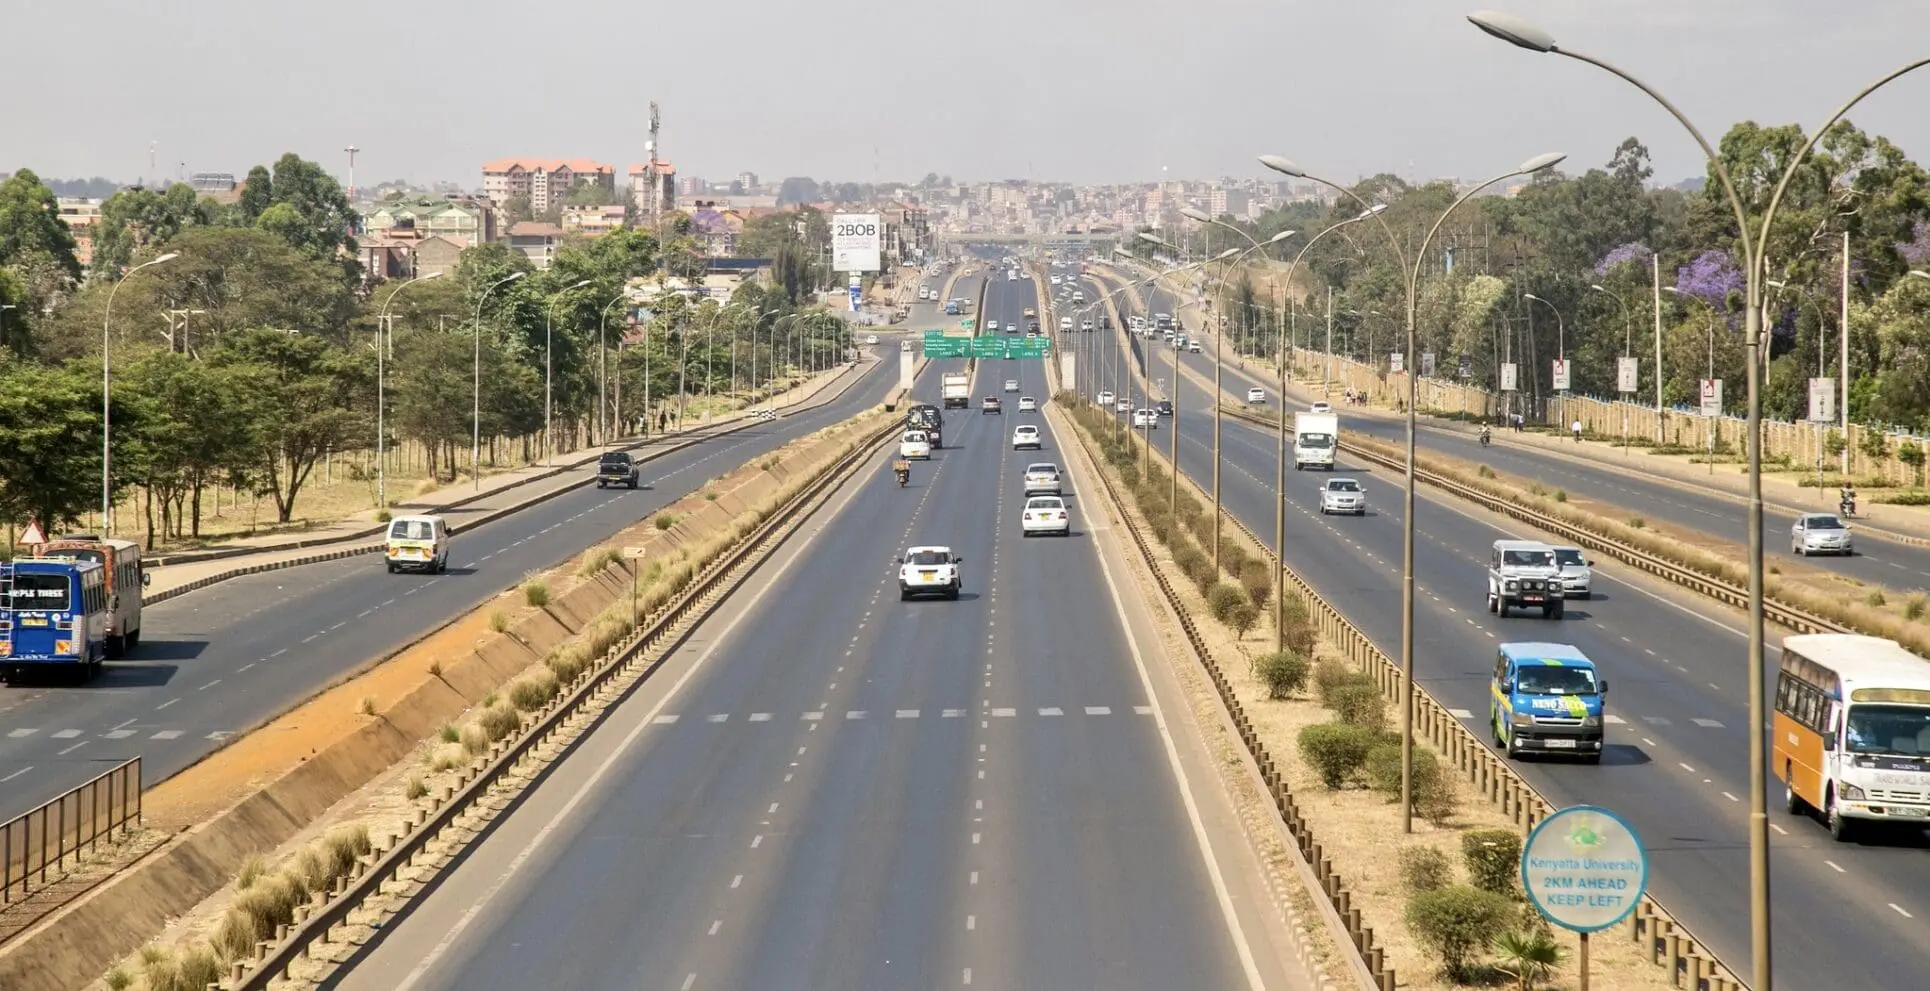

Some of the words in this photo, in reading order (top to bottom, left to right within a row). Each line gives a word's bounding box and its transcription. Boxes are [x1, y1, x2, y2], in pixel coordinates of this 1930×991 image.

[837, 224, 876, 236] 2BOB
[1530, 858, 1580, 872] Kenyatta
[1584, 857, 1639, 872] University
[1544, 877, 1573, 888] 2KM
[1579, 878, 1627, 889] AHEAD
[1548, 894, 1584, 906] KEEP
[1589, 895, 1624, 907] LEFT
